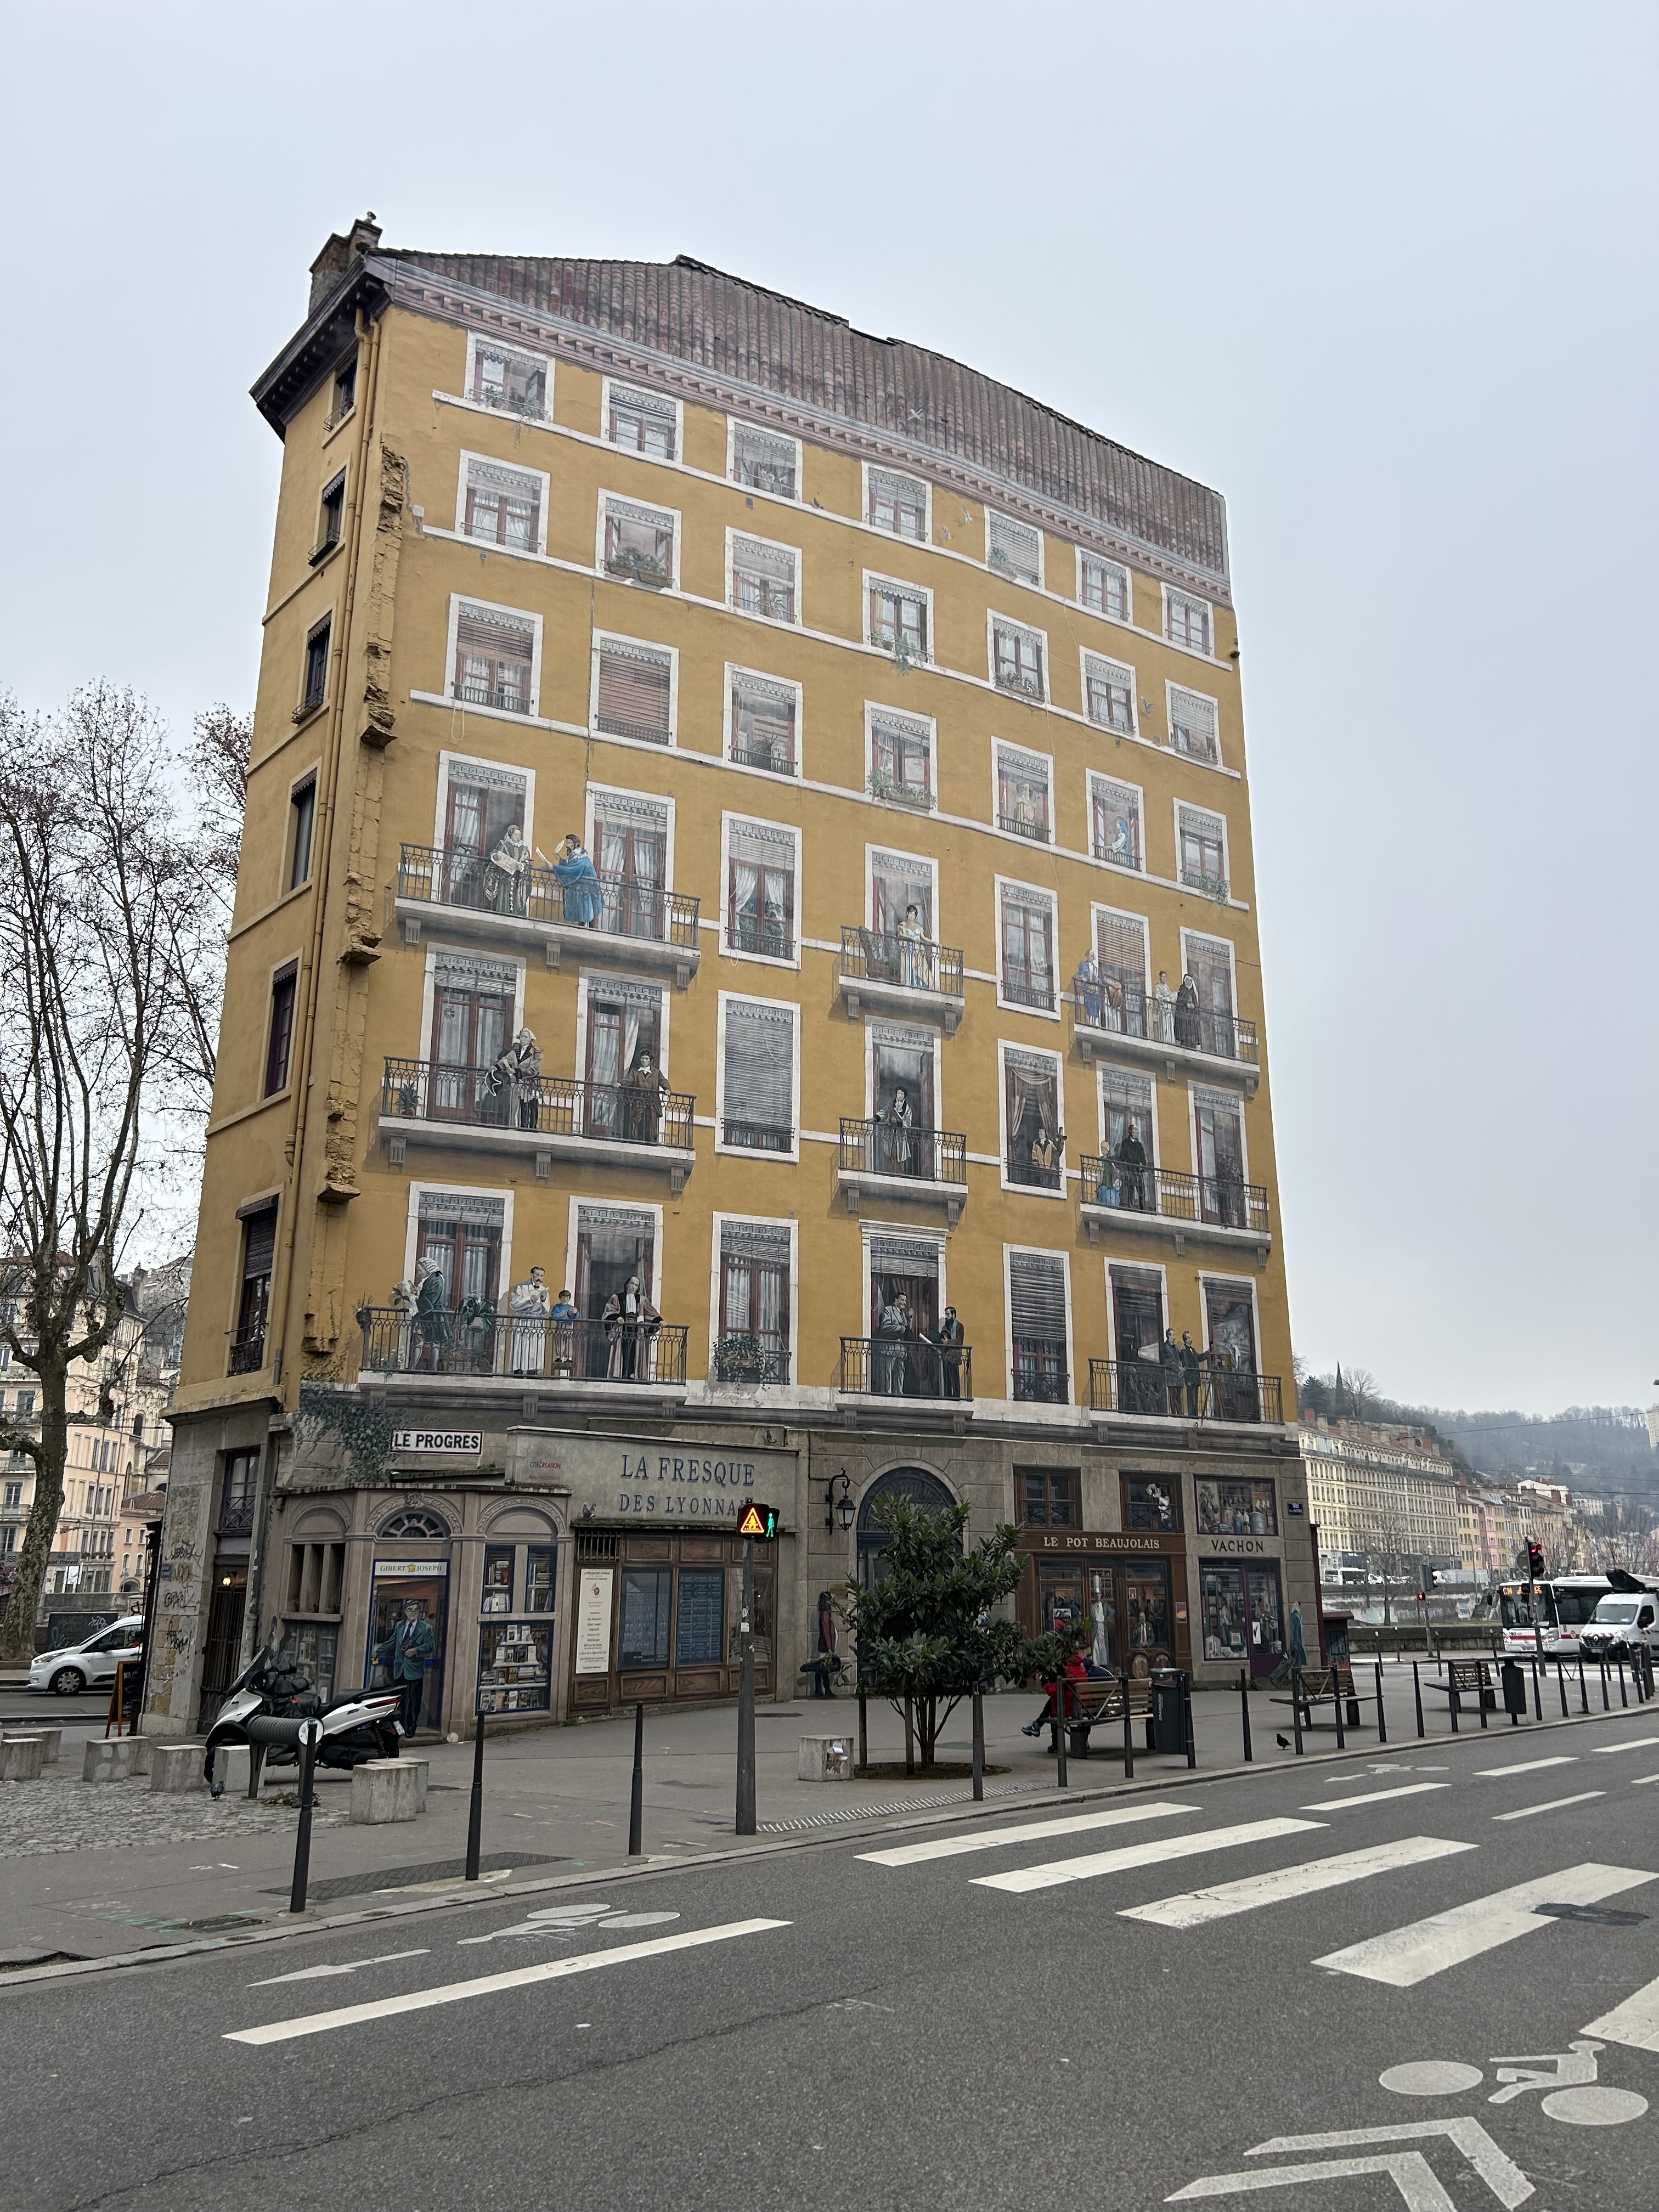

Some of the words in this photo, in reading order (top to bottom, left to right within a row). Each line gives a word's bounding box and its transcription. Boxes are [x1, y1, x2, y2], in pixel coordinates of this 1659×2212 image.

[394, 1433, 411, 1447] LE
[620, 1454, 650, 1480] LA
[658, 1457, 755, 1487] FRESQUE
[618, 1494, 655, 1512] DES
[665, 1496, 744, 1516] LYONNA
[1044, 1537, 1058, 1547] LE
[1066, 1537, 1088, 1548] POT
[1095, 1538, 1160, 1549] BEAUJOLAIS
[1211, 1539, 1264, 1553] VACHON
[1503, 1587, 1513, 1595] C14
